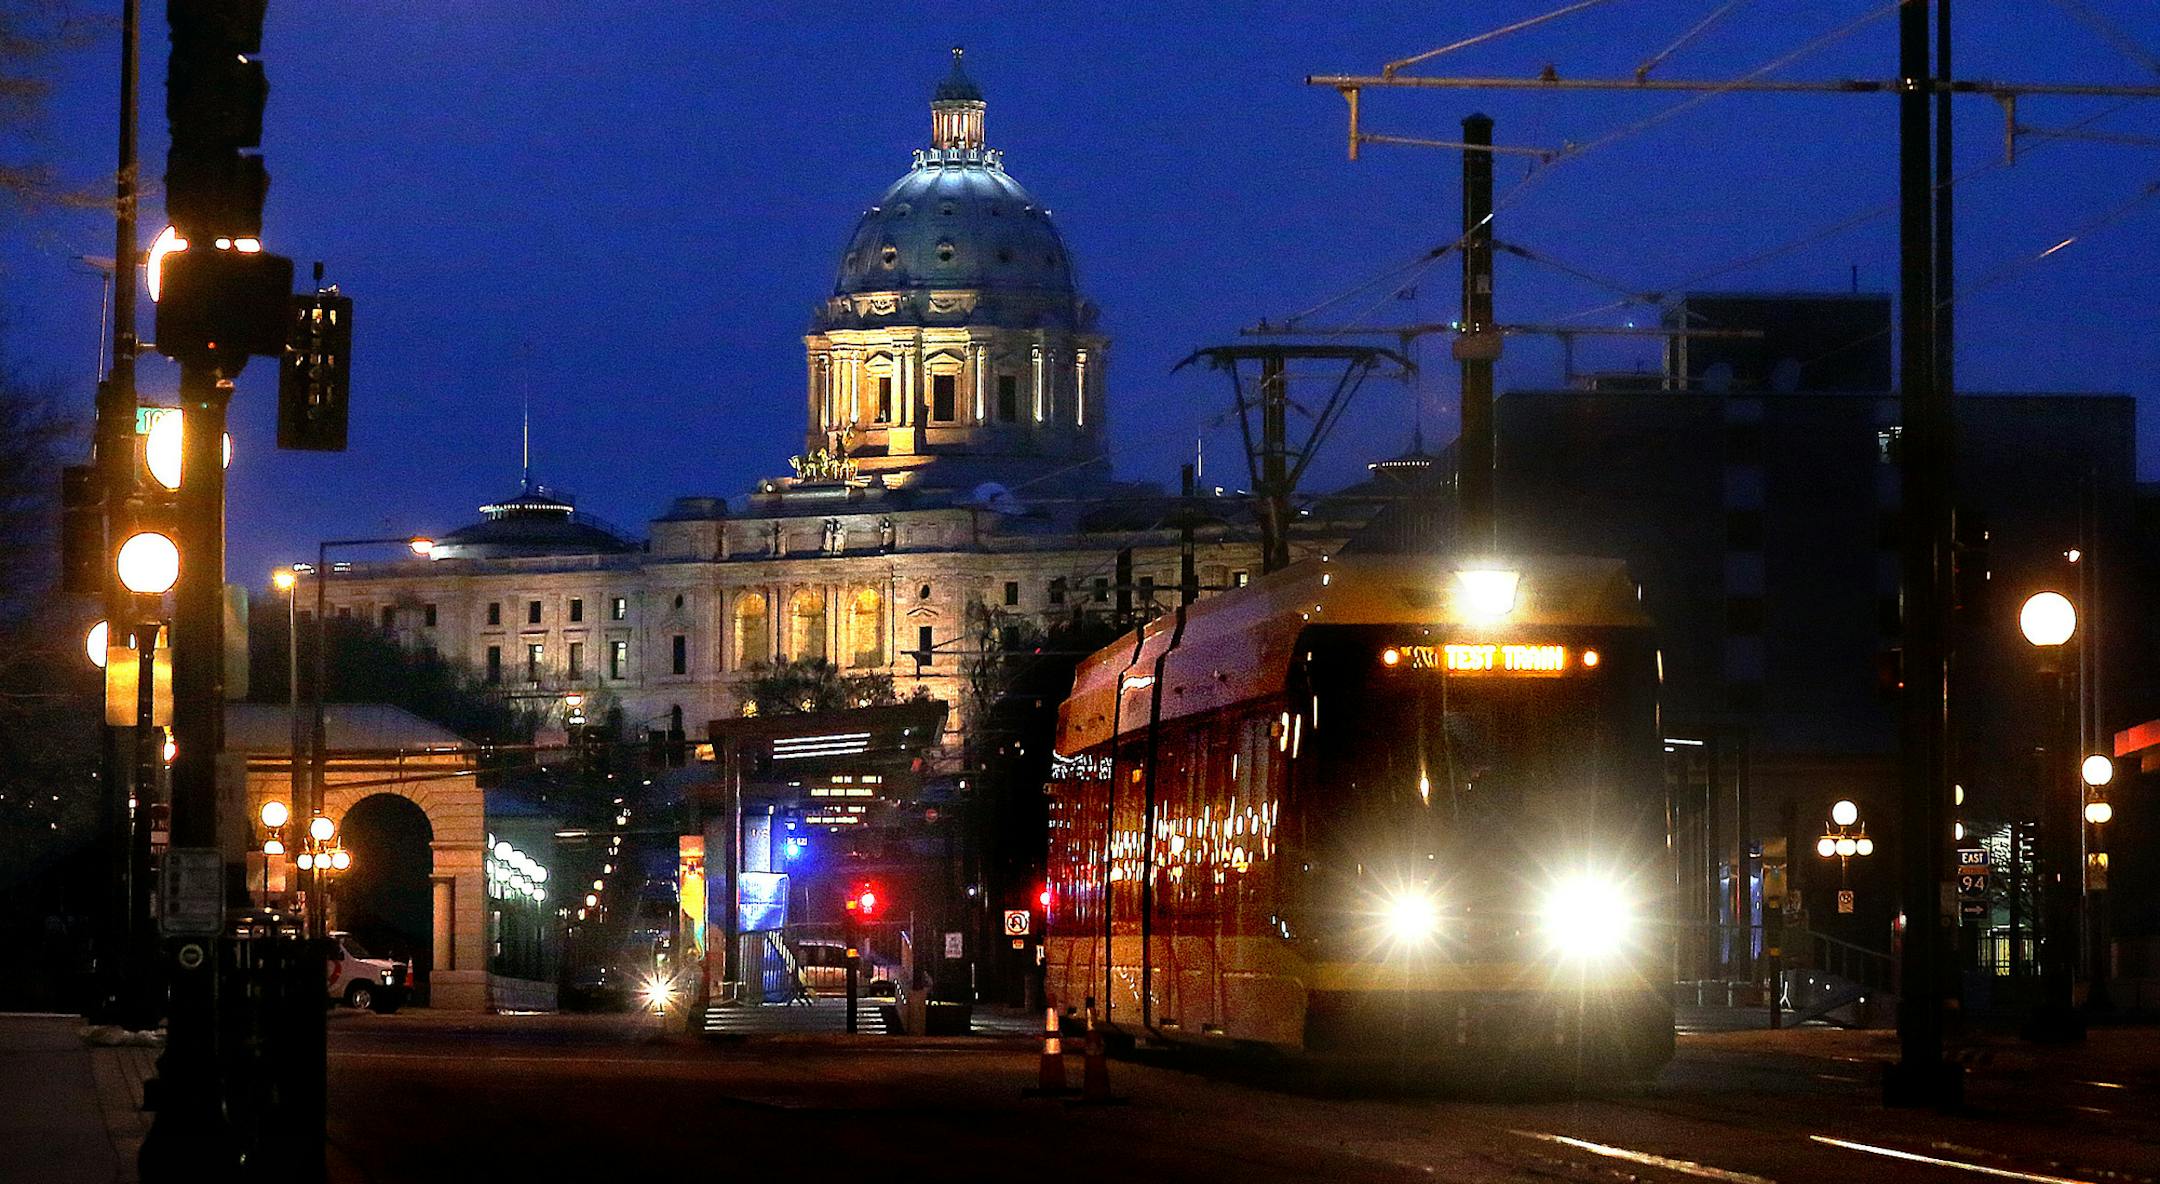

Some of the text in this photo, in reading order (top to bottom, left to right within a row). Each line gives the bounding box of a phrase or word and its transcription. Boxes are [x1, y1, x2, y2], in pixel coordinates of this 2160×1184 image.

[1444, 644, 1496, 670] TEST
[1502, 644, 1564, 671] TRAIN
[1961, 853, 1984, 864] EAST
[1962, 876, 1985, 891] 94
